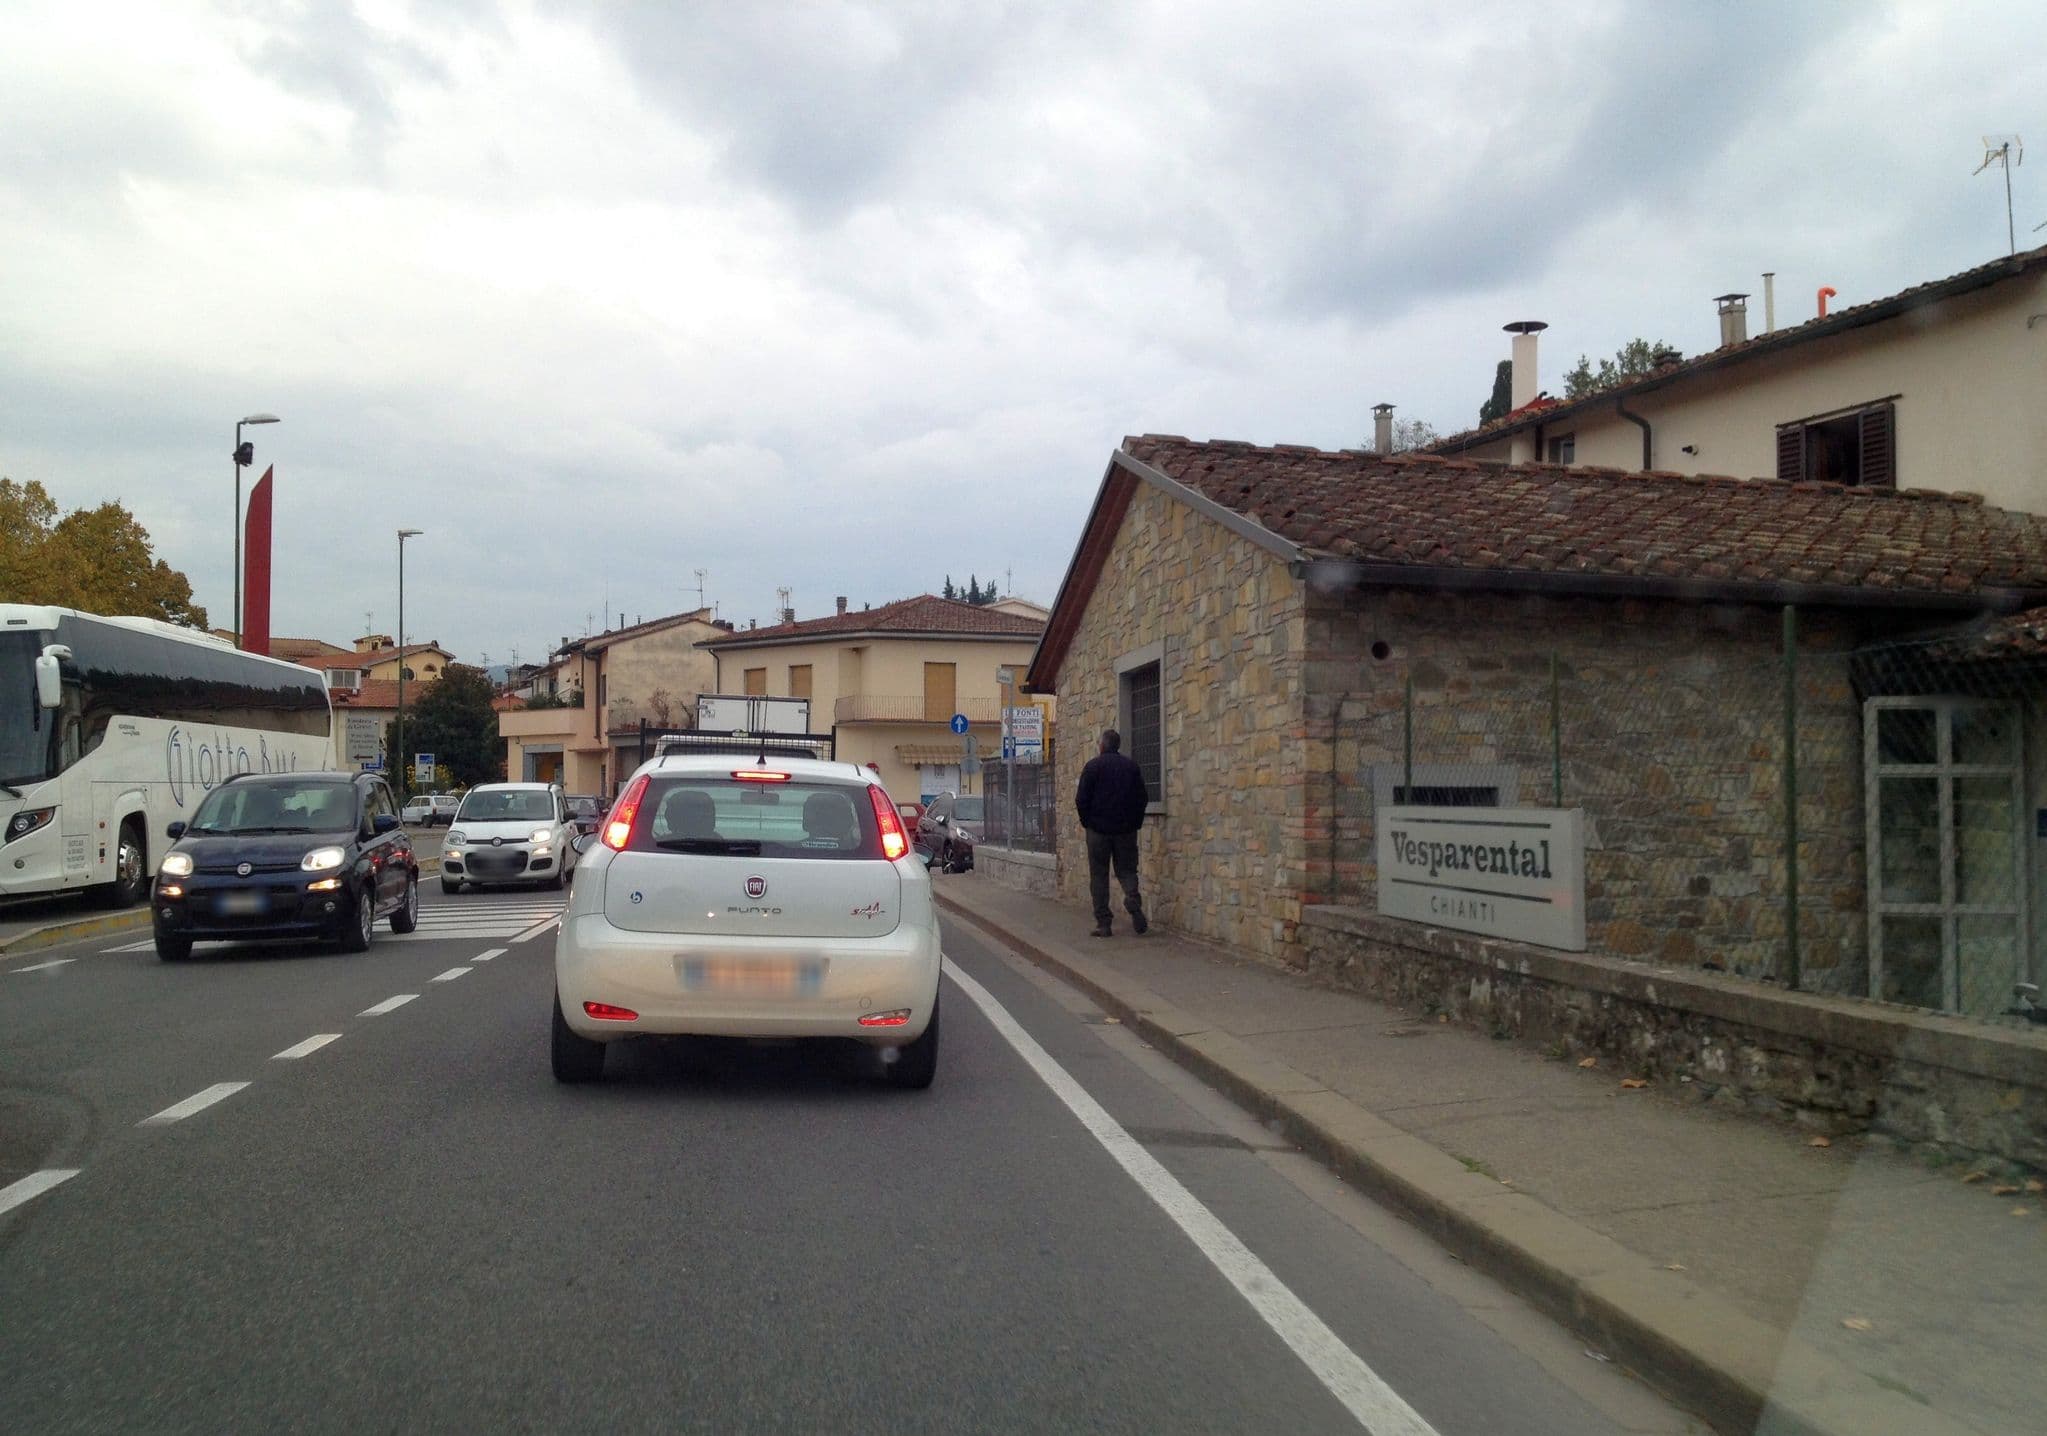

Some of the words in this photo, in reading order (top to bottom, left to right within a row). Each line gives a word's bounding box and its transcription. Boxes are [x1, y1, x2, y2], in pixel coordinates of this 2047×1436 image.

[166, 725, 250, 808] Giotto
[1390, 830, 1553, 879] Vesparental
[749, 881, 763, 892] FIAT
[1430, 895, 1496, 923] CHIANTI
